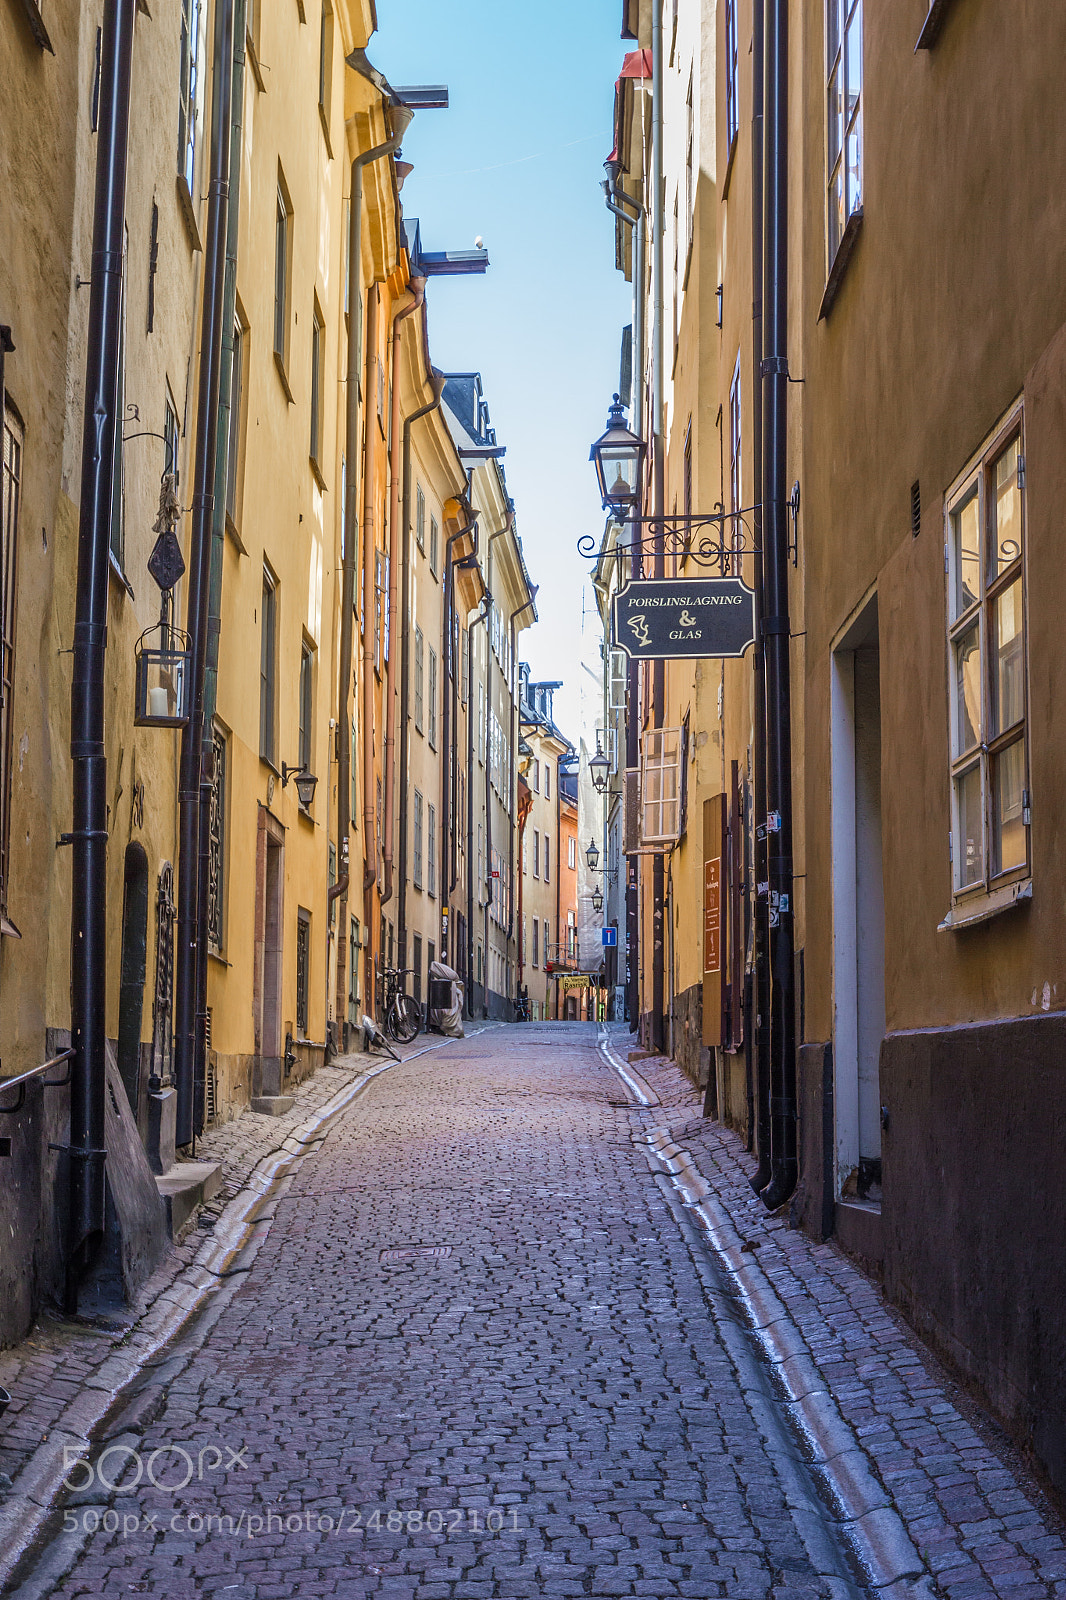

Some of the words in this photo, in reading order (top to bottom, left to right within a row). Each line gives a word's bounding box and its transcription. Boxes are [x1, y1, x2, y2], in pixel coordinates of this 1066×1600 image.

[628, 595, 743, 607] PORSLINSLAGNING
[679, 609, 697, 627] &
[669, 630, 702, 640] GLAS
